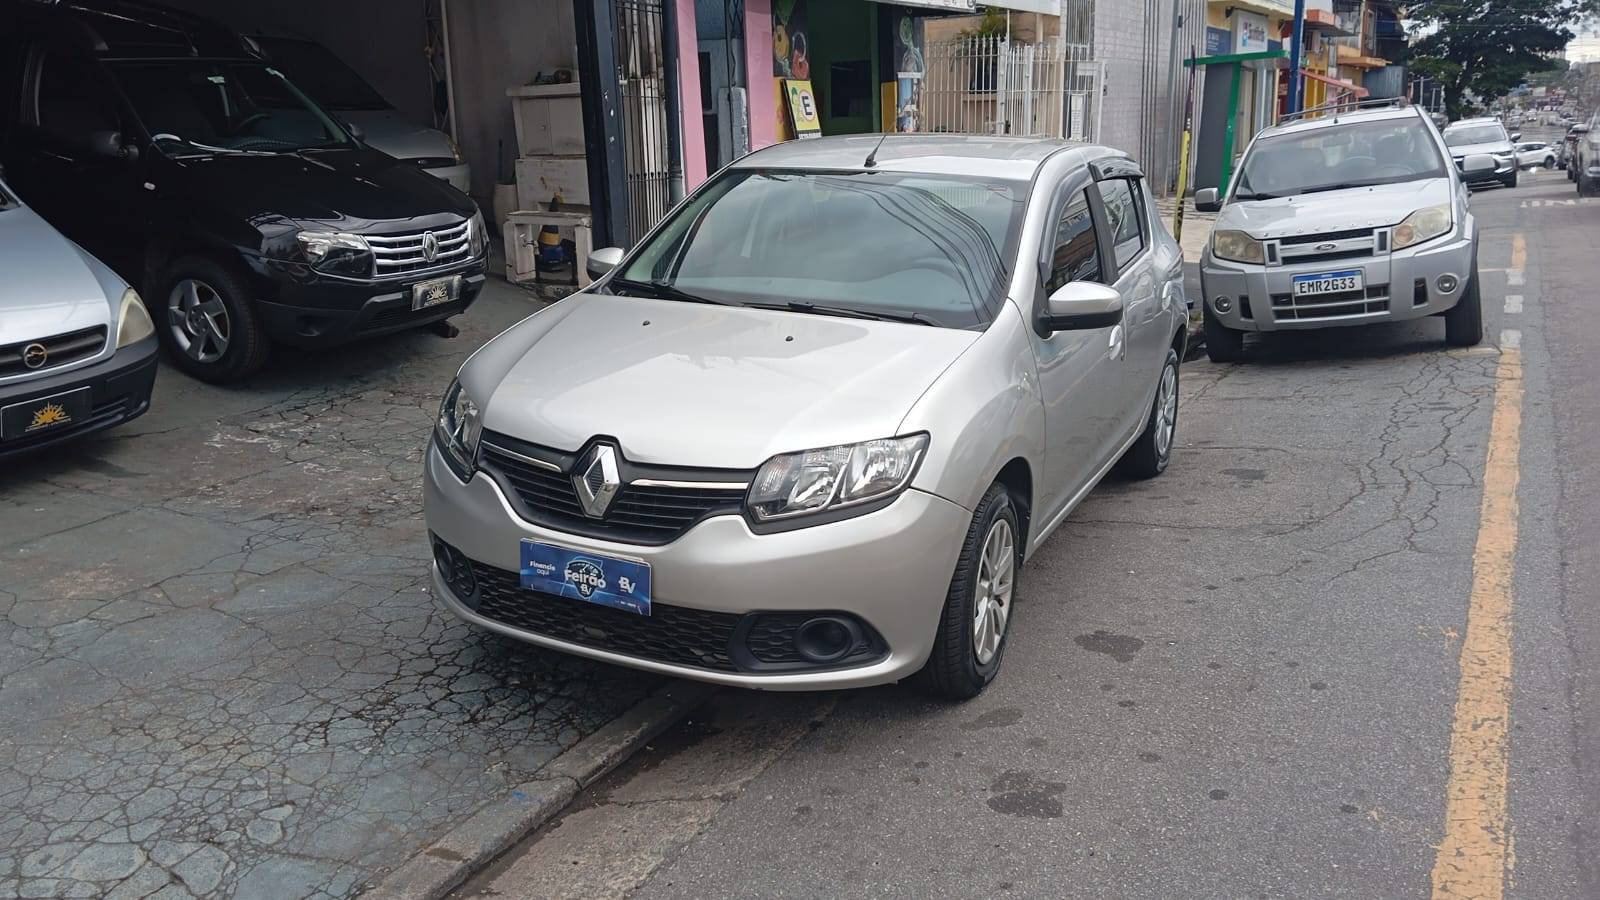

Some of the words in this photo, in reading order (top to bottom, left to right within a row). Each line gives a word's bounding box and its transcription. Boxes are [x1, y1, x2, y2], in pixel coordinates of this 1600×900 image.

[802, 95, 813, 116] E
[1299, 277, 1355, 294] EMR2G33
[564, 569, 606, 588] Feirão
[618, 576, 636, 594] BV
